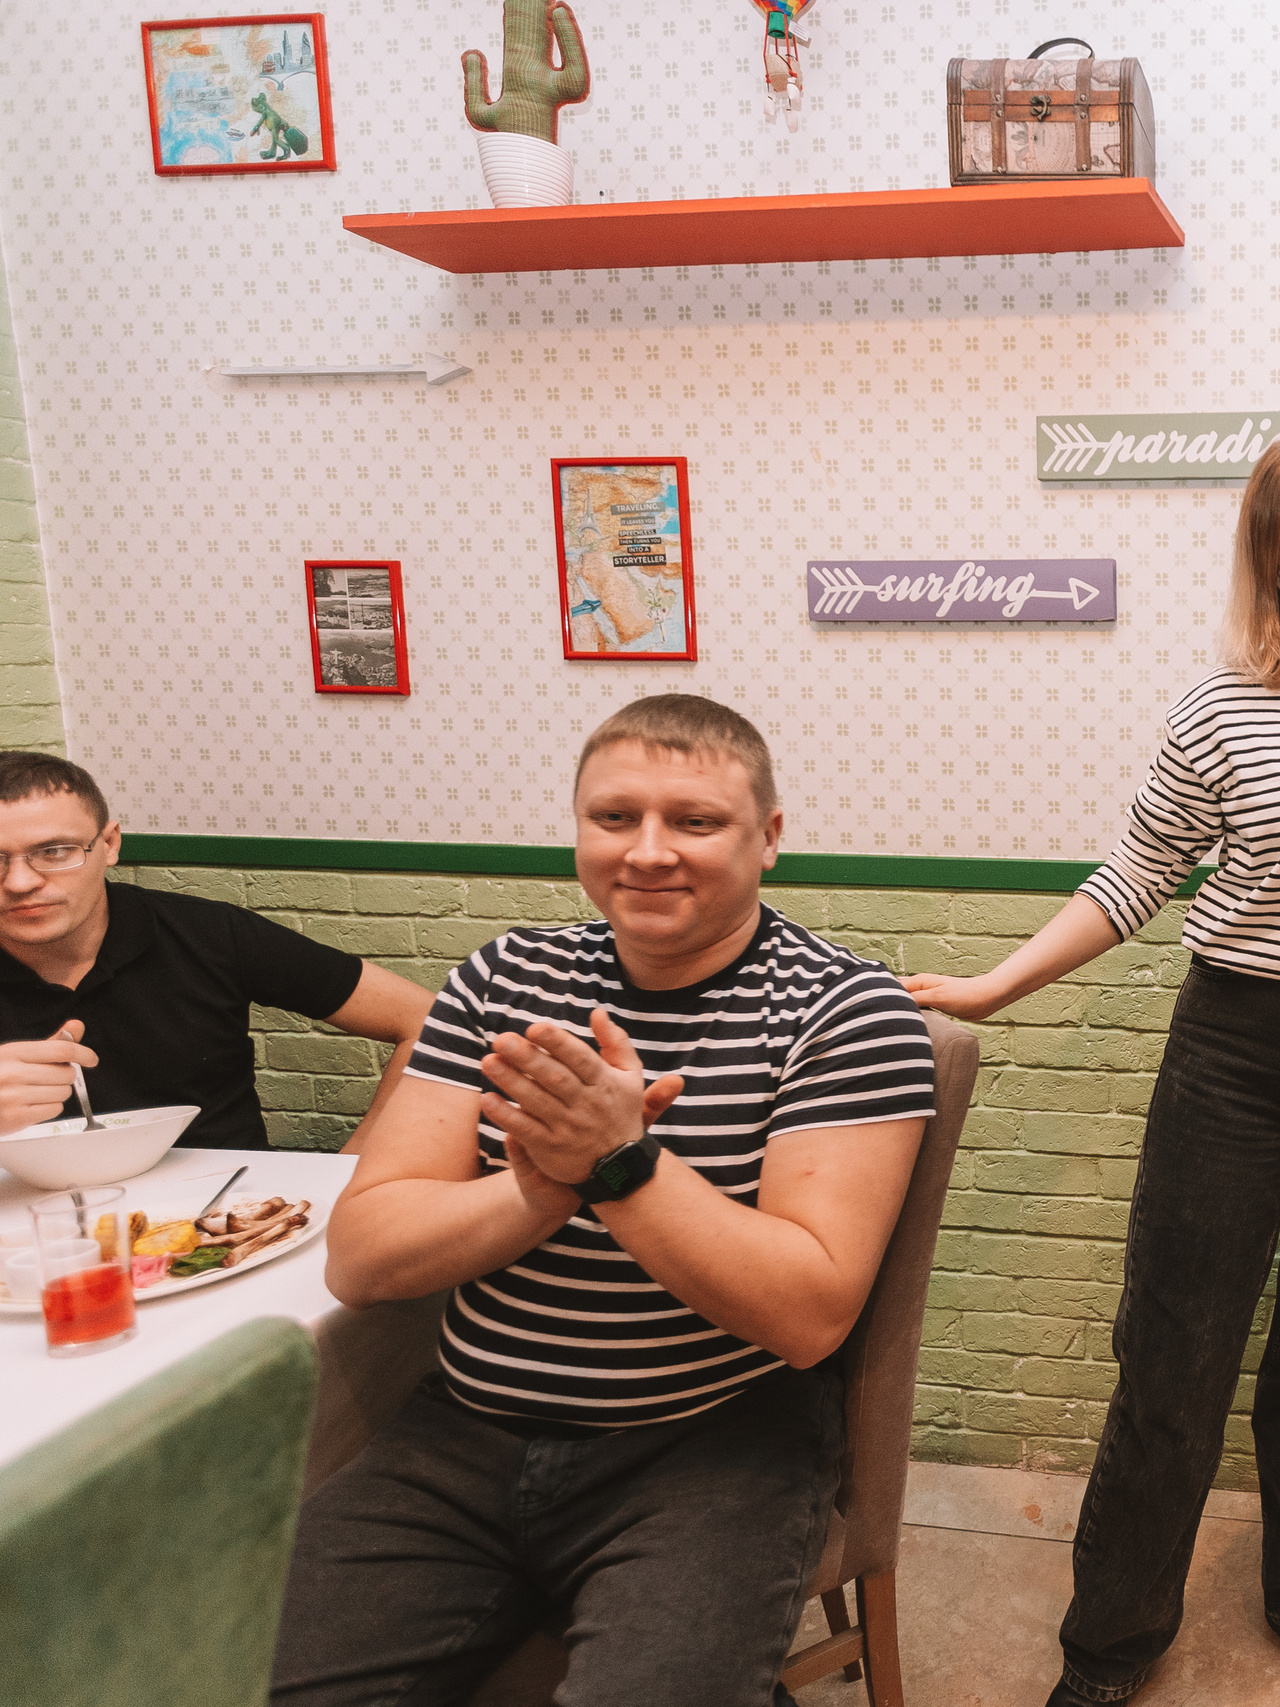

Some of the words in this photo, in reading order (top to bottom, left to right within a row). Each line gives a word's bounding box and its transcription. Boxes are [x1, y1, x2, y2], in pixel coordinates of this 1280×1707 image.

[616, 503, 660, 512] TRAVELING.
[614, 555, 666, 565] STORYTELLER.
[876, 561, 1035, 618] surfing
